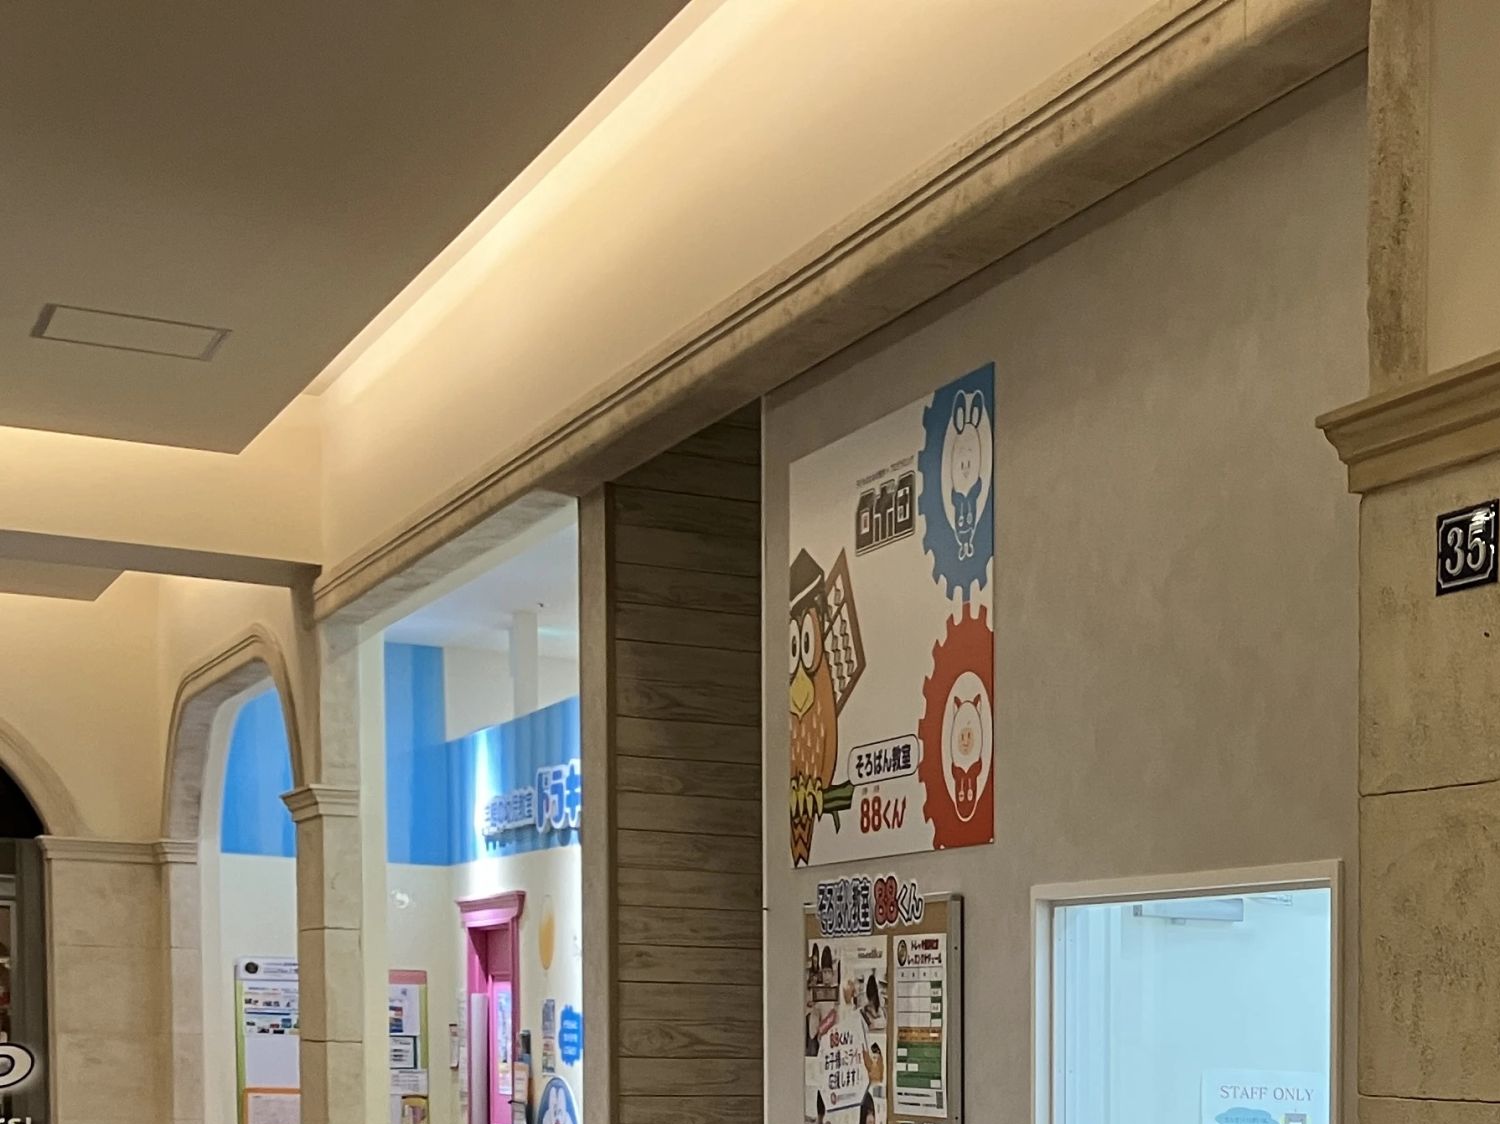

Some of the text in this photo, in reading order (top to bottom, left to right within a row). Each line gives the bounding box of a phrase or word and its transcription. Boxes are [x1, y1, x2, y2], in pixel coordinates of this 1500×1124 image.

[1445, 522, 1486, 576] 35
[856, 744, 911, 779] そろばん教室
[860, 795, 906, 834] 88くん
[873, 874, 924, 926] 88くん
[1220, 1085, 1314, 1101] STAFF ONLY
